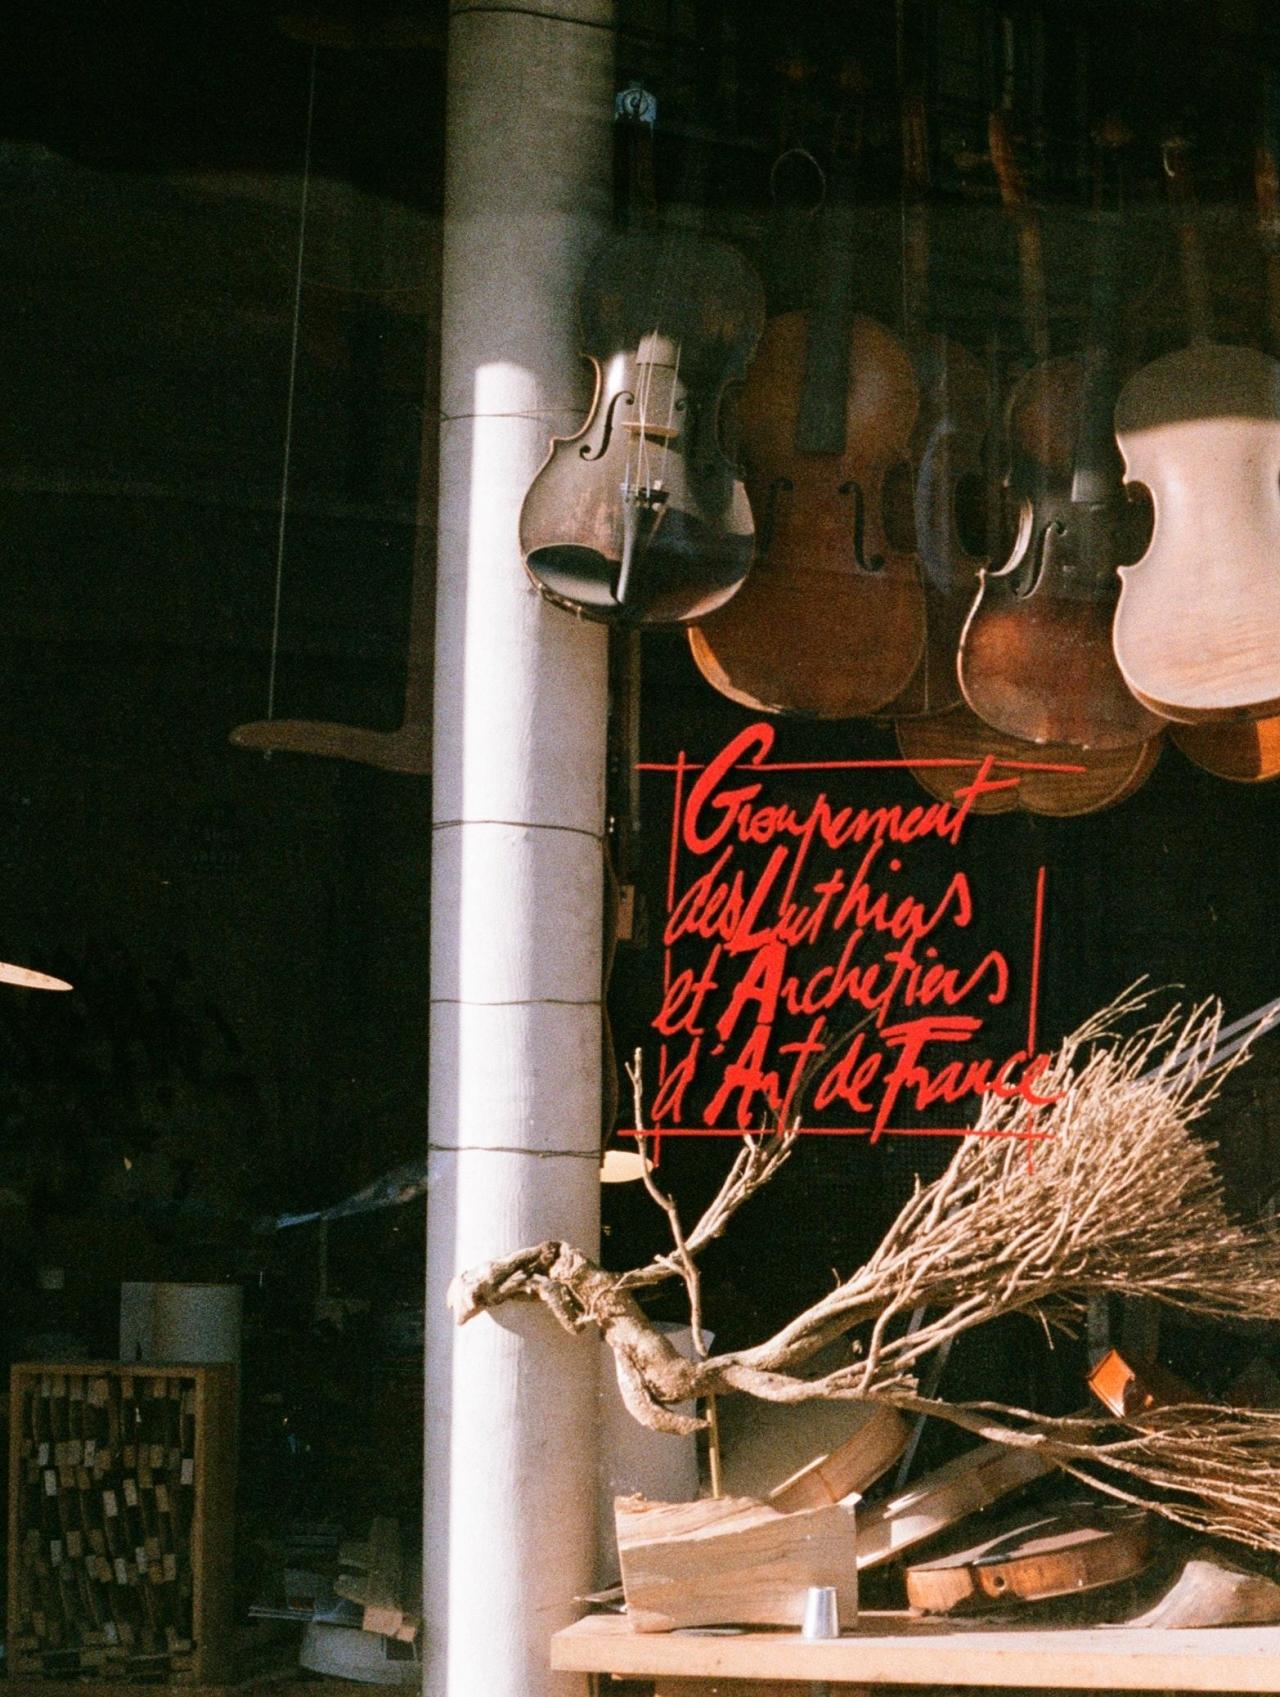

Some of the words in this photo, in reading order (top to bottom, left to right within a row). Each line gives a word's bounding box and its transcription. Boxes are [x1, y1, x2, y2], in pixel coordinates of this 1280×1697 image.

[683, 723, 1020, 917] Groupement
[665, 846, 745, 944] des
[652, 944, 718, 1037] et
[652, 1016, 826, 1136] d'Art
[815, 1033, 881, 1111] de
[870, 1016, 1066, 1143] France
